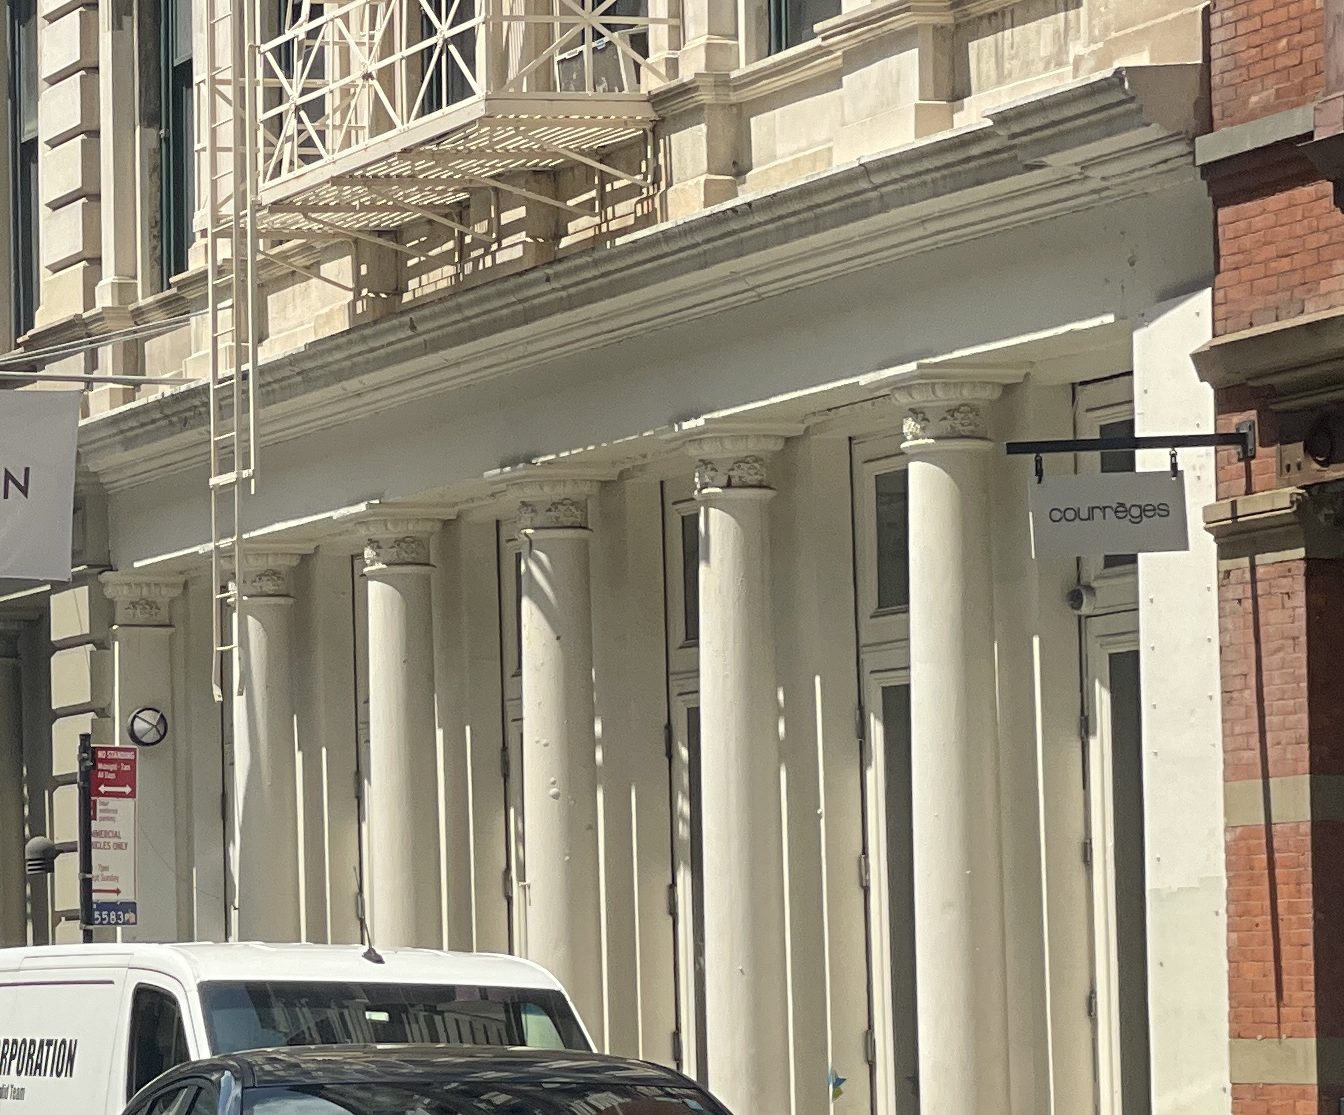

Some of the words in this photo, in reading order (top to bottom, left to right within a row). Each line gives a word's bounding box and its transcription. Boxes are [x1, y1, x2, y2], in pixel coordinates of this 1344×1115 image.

[1048, 502, 1171, 525] courrèges
[107, 750, 135, 760] STANDING
[10, 1083, 26, 1101] Team
